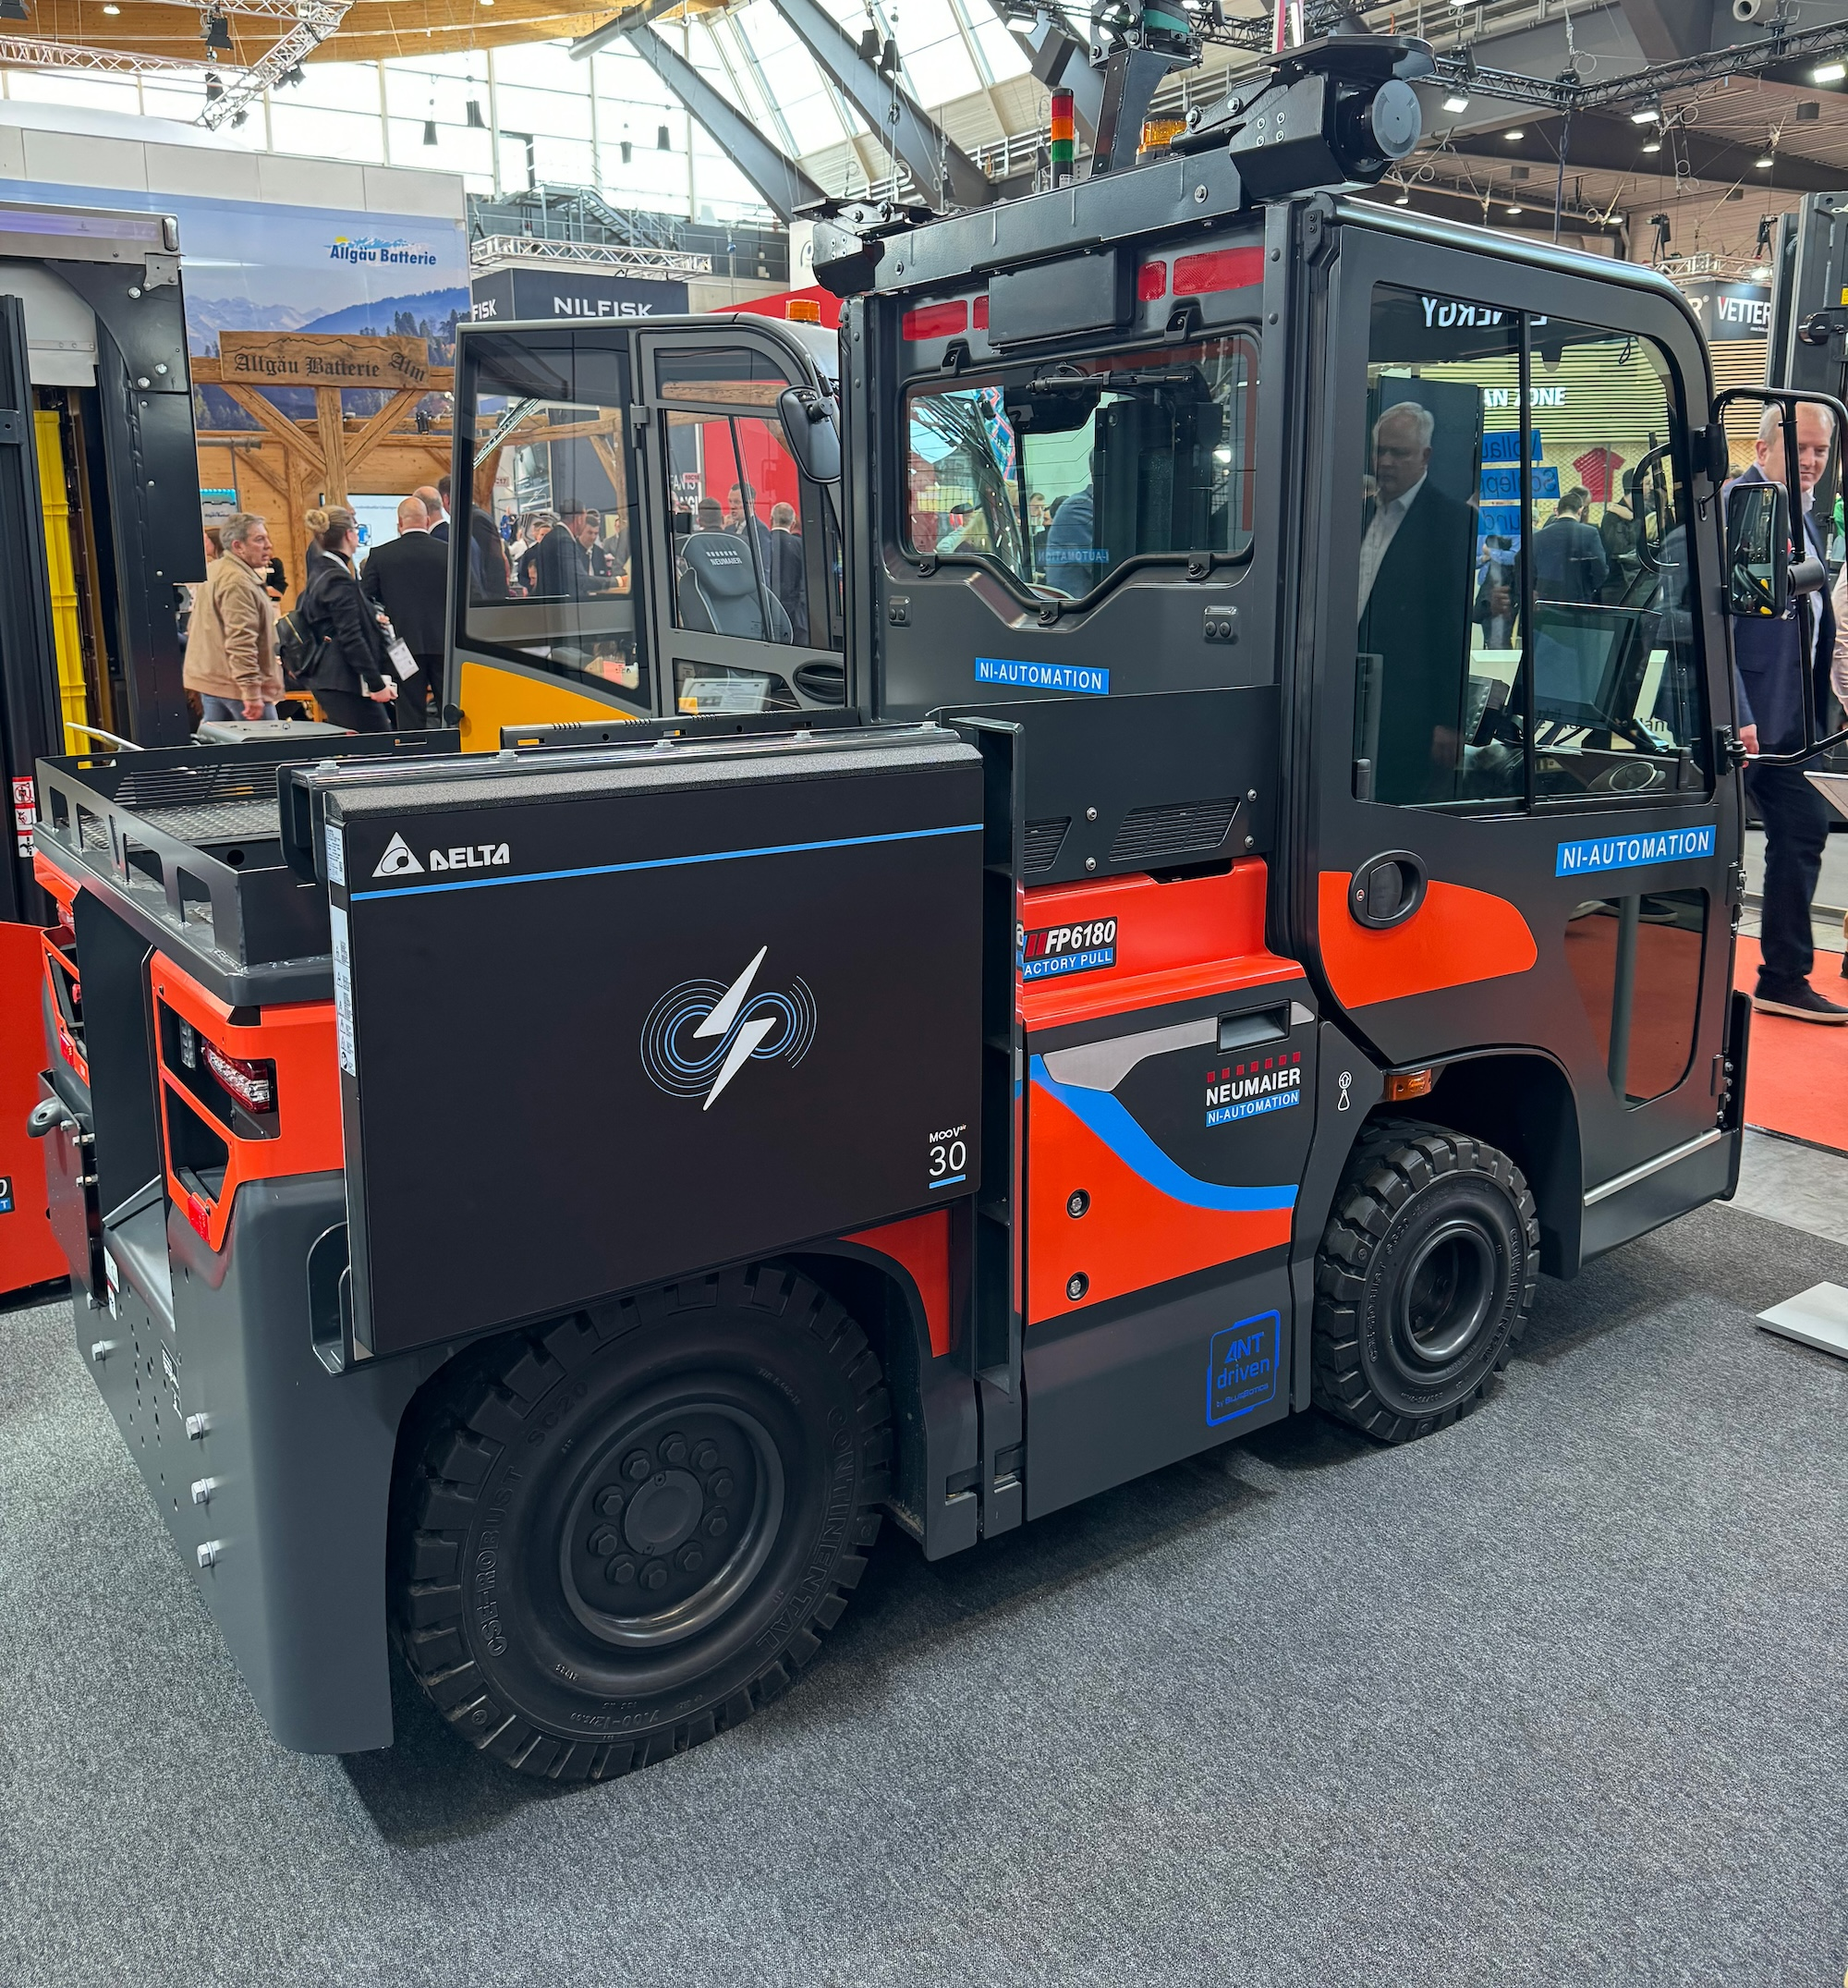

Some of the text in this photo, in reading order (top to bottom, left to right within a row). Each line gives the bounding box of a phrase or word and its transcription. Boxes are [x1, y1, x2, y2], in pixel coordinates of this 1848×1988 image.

[330, 245, 437, 265] Allgäu Batterie
[553, 297, 652, 317] NILFISK
[234, 351, 425, 382] Allgäu Batterie Alm
[1483, 388, 1509, 408] AN
[979, 662, 1103, 690] NI-AUTOMATION
[429, 842, 511, 872] DELTA
[1562, 830, 1710, 871] NI-AUTOMATION
[1044, 920, 1116, 955] FP6180
[1022, 950, 1112, 978] ACTORY PULL
[1206, 1067, 1301, 1107] NEUMAIER
[1208, 1092, 1299, 1125] NI-AUTOMATION
[929, 1140, 967, 1177] 30
[1224, 1331, 1265, 1364] ANT
[1217, 1358, 1270, 1389] driven
[756, 1404, 856, 1650] CONTINENTAL
